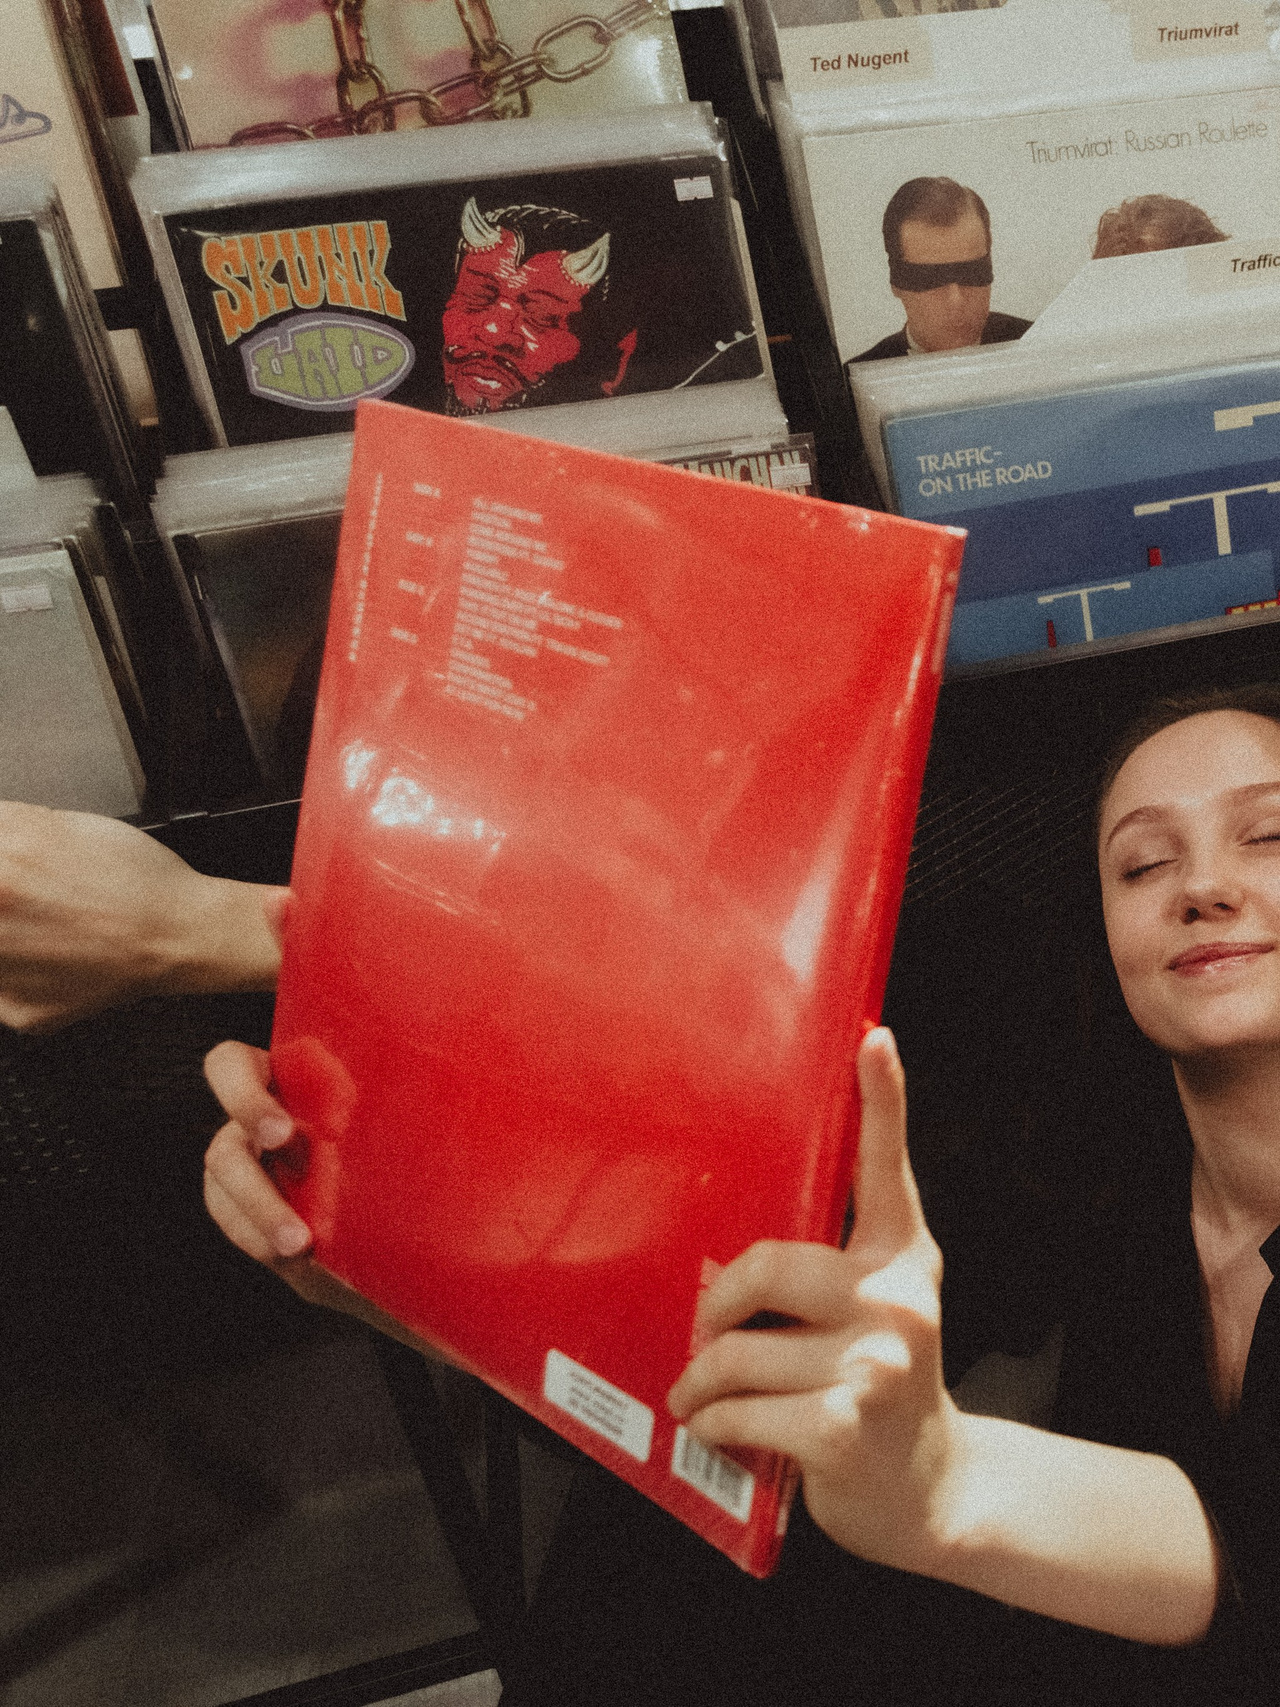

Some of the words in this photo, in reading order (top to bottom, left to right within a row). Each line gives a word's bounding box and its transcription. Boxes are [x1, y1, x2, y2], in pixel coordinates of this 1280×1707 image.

[1157, 21, 1240, 43] Triumvirat
[810, 55, 842, 73] Ted
[847, 49, 910, 72] Nugent
[1124, 128, 1192, 152] Russian
[202, 220, 407, 346] SKUNK
[918, 476, 953, 497] ON
[956, 469, 993, 491] THE
[994, 460, 1052, 485] ROAD
